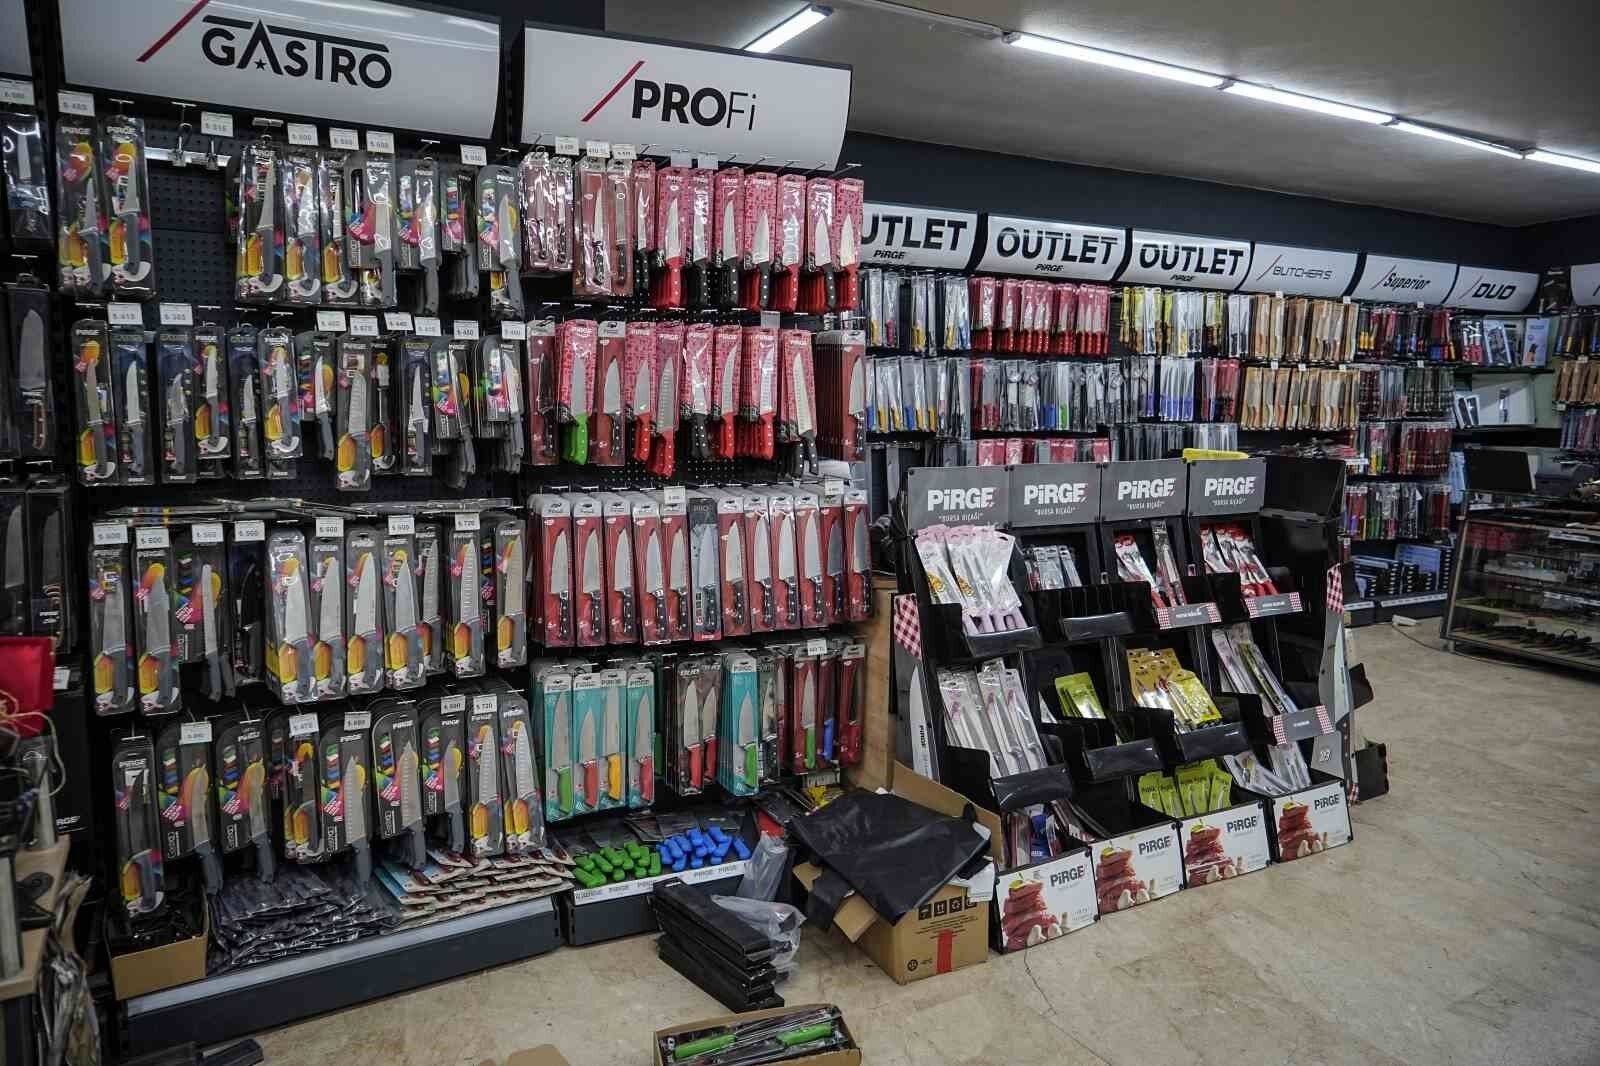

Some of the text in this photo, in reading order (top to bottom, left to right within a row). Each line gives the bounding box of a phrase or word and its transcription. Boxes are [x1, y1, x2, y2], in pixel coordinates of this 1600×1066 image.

[202, 15, 391, 89] GASTRO
[861, 213, 967, 251] UTLET
[996, 227, 1118, 265] OUTLET
[1139, 243, 1244, 276] OUTLET
[1384, 272, 1431, 291] Superior
[1472, 282, 1516, 300] DUO
[1024, 482, 1088, 505] PiRGE
[1118, 477, 1176, 500] PiRGE
[1205, 475, 1257, 497] PiRGE
[927, 486, 997, 511] PiRGE
[1314, 793, 1340, 810] PiRGE
[1226, 816, 1258, 833] PiRGE
[1138, 835, 1171, 855] PiRGE
[1050, 864, 1085, 887] PiRGE
